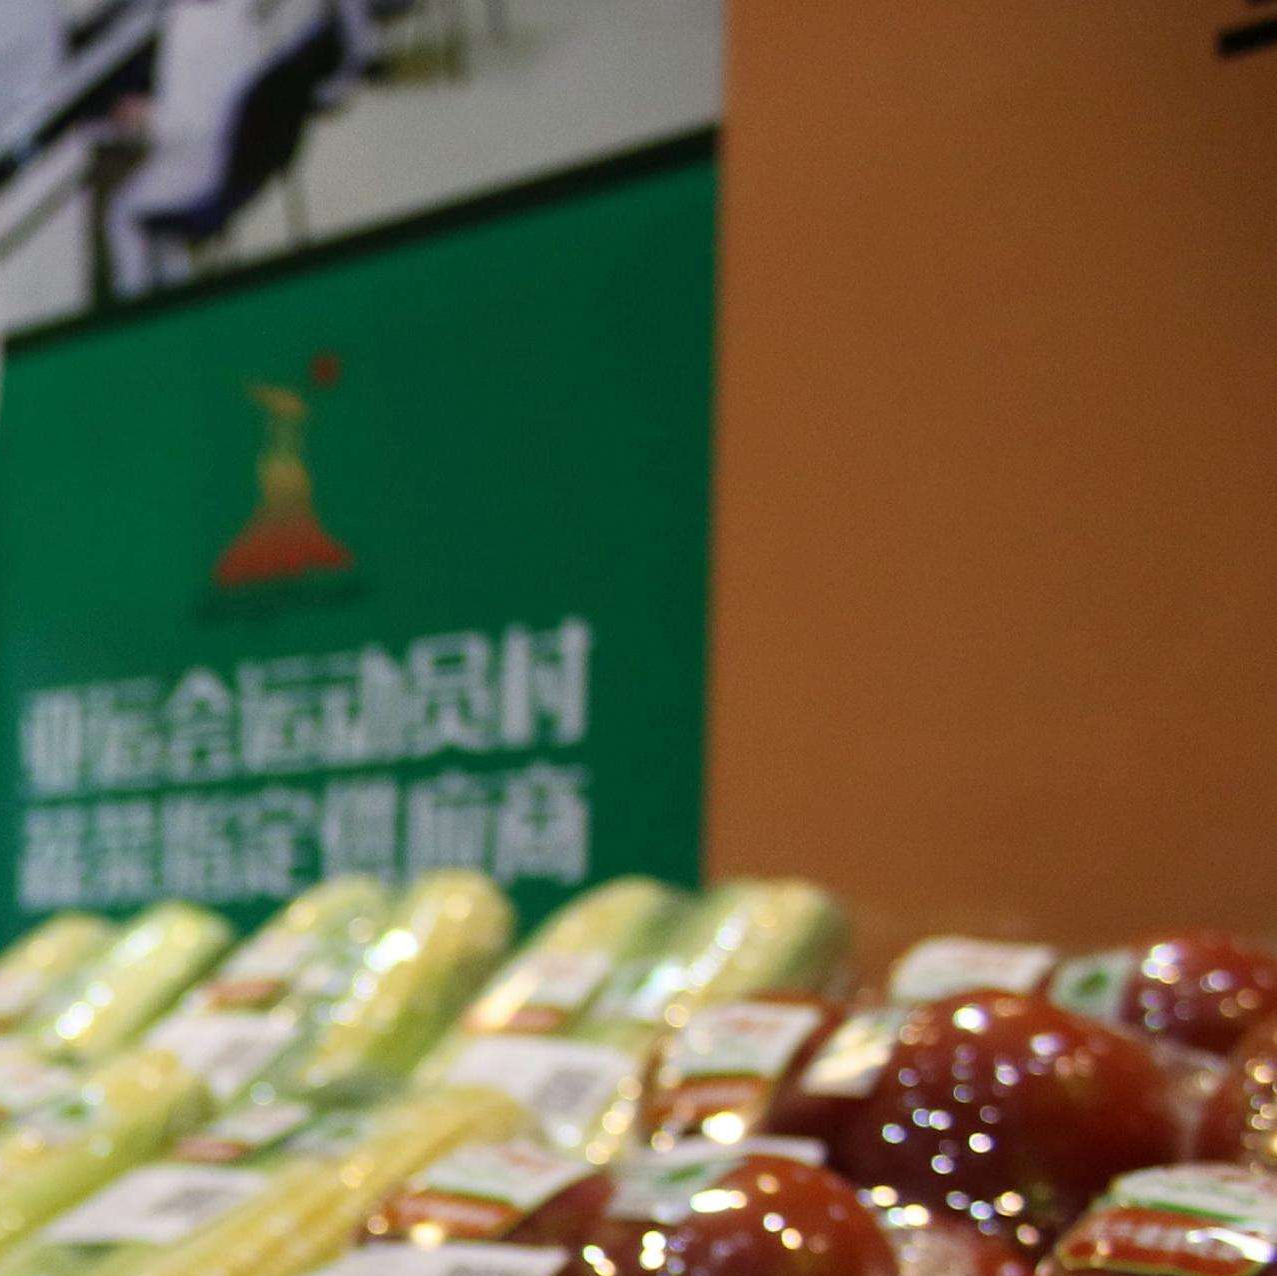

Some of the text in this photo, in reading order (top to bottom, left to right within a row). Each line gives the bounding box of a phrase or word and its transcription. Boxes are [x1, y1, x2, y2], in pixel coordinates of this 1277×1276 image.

[21, 617, 589, 796] 亚运会运动员村
[18, 761, 589, 910] 蔬菜指定供应商
